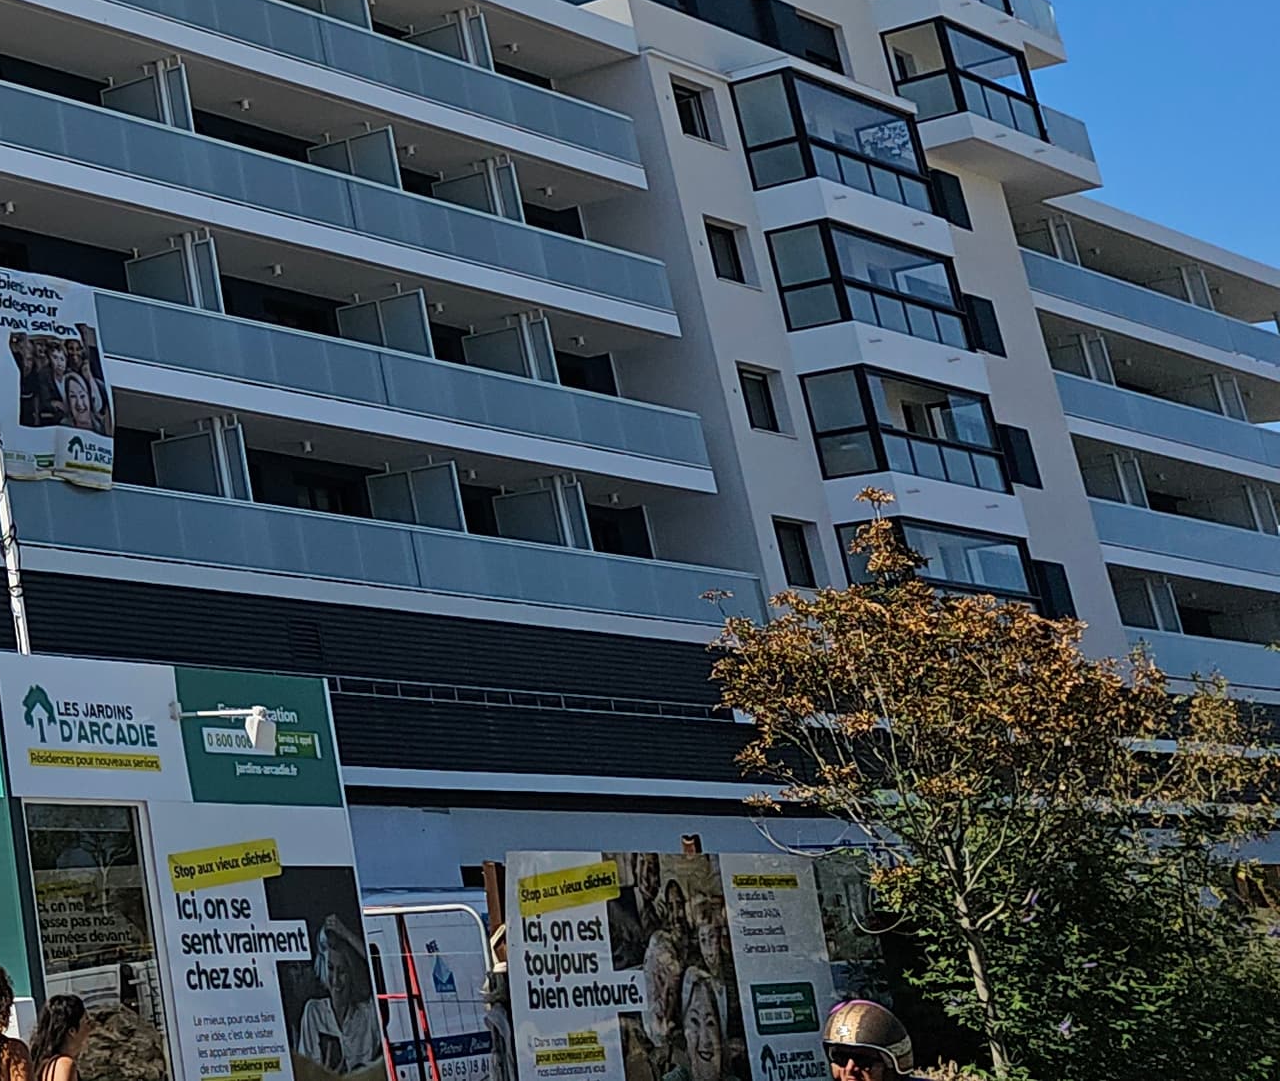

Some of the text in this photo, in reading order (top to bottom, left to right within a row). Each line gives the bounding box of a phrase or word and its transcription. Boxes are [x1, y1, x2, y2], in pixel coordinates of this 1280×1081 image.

[56, 701, 133, 720] LES JARDINS
[59, 719, 158, 747] D'ARCADIE
[174, 865, 196, 879] Stop
[198, 863, 215, 875] aux
[215, 857, 240, 871] vieux
[175, 891, 251, 923] Ici, on se
[521, 889, 541, 903] Stop
[543, 886, 559, 898] aux
[559, 880, 582, 895] vieux
[182, 924, 308, 954] sent vraiment
[522, 914, 604, 948] Ici, on est
[186, 957, 264, 990] chez soi.
[524, 944, 599, 982] toujours
[528, 975, 643, 1009] bien entouré.
